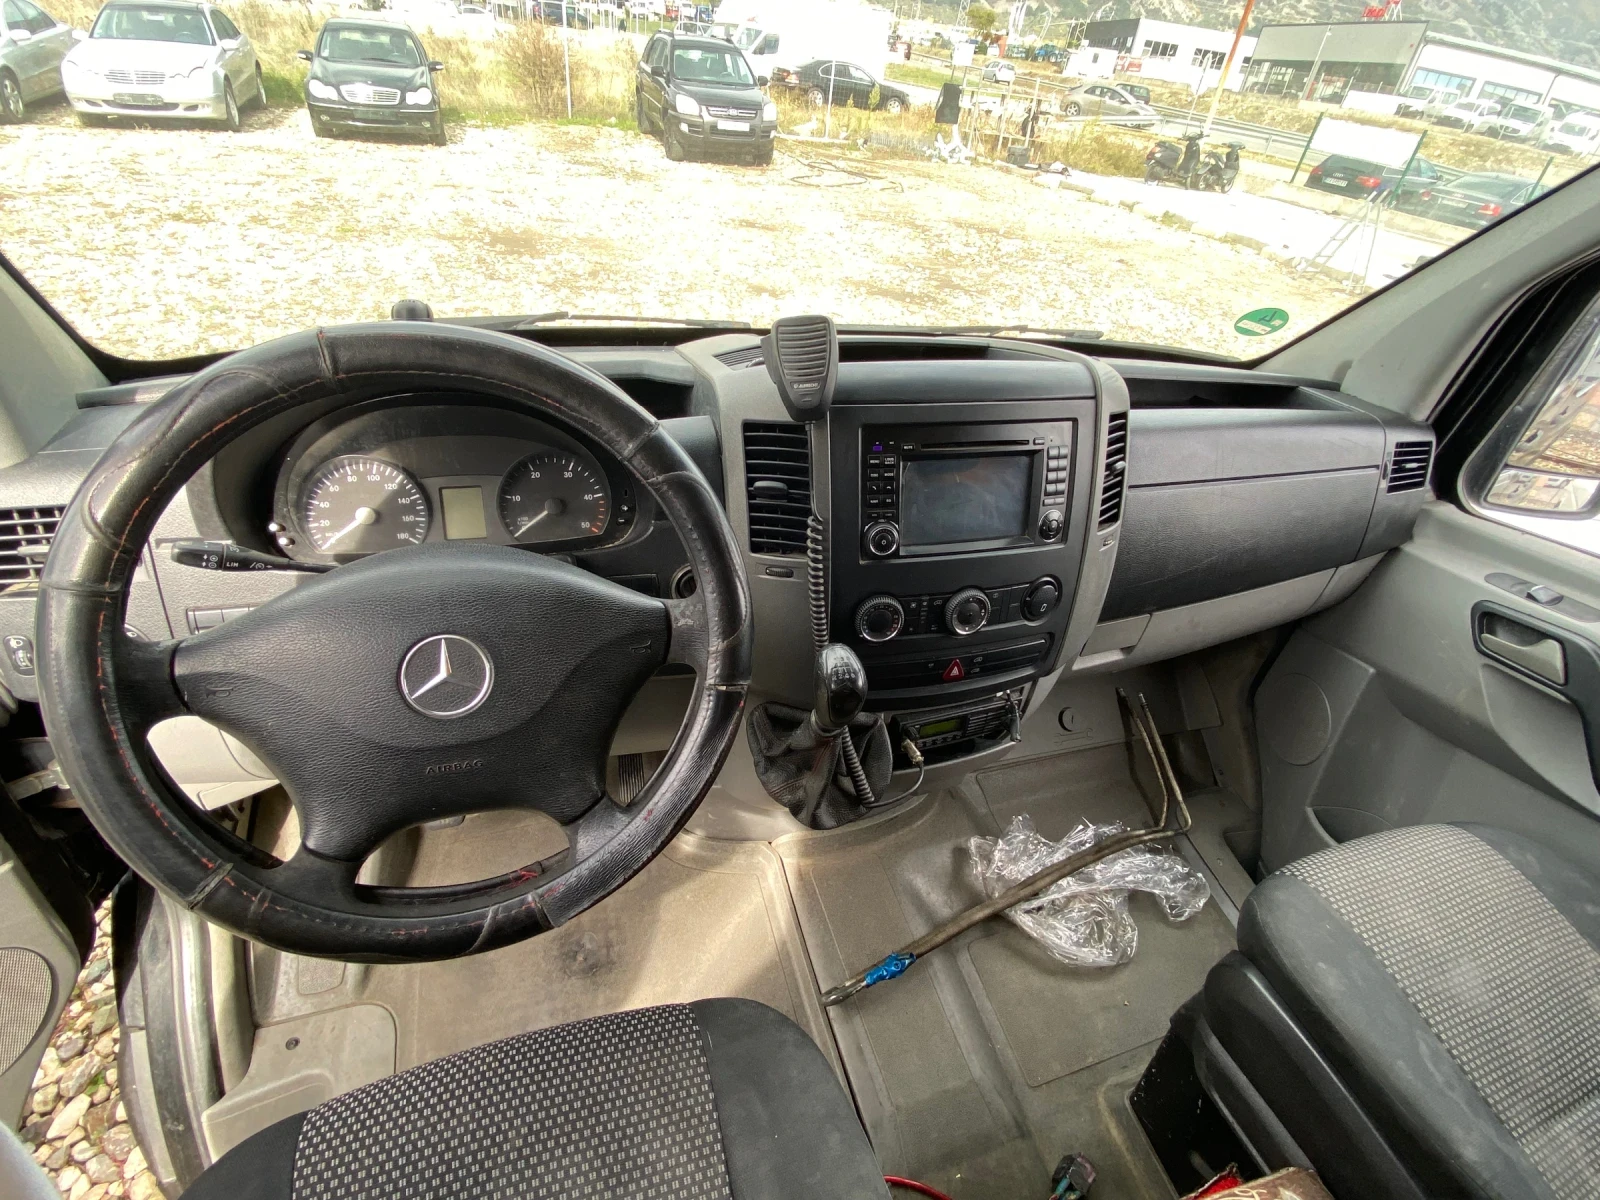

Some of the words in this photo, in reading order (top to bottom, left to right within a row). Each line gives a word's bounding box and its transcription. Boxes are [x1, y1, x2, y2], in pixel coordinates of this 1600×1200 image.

[367, 474, 381, 482] 100
[530, 471, 541, 479] 20
[329, 484, 340, 492] 60
[511, 494, 521, 502] 10
[319, 501, 330, 509] 40
[319, 519, 330, 527] 20
[580, 521, 590, 529] 50
[396, 532, 409, 540] 180
[425, 759, 485, 775] AIRBAG
